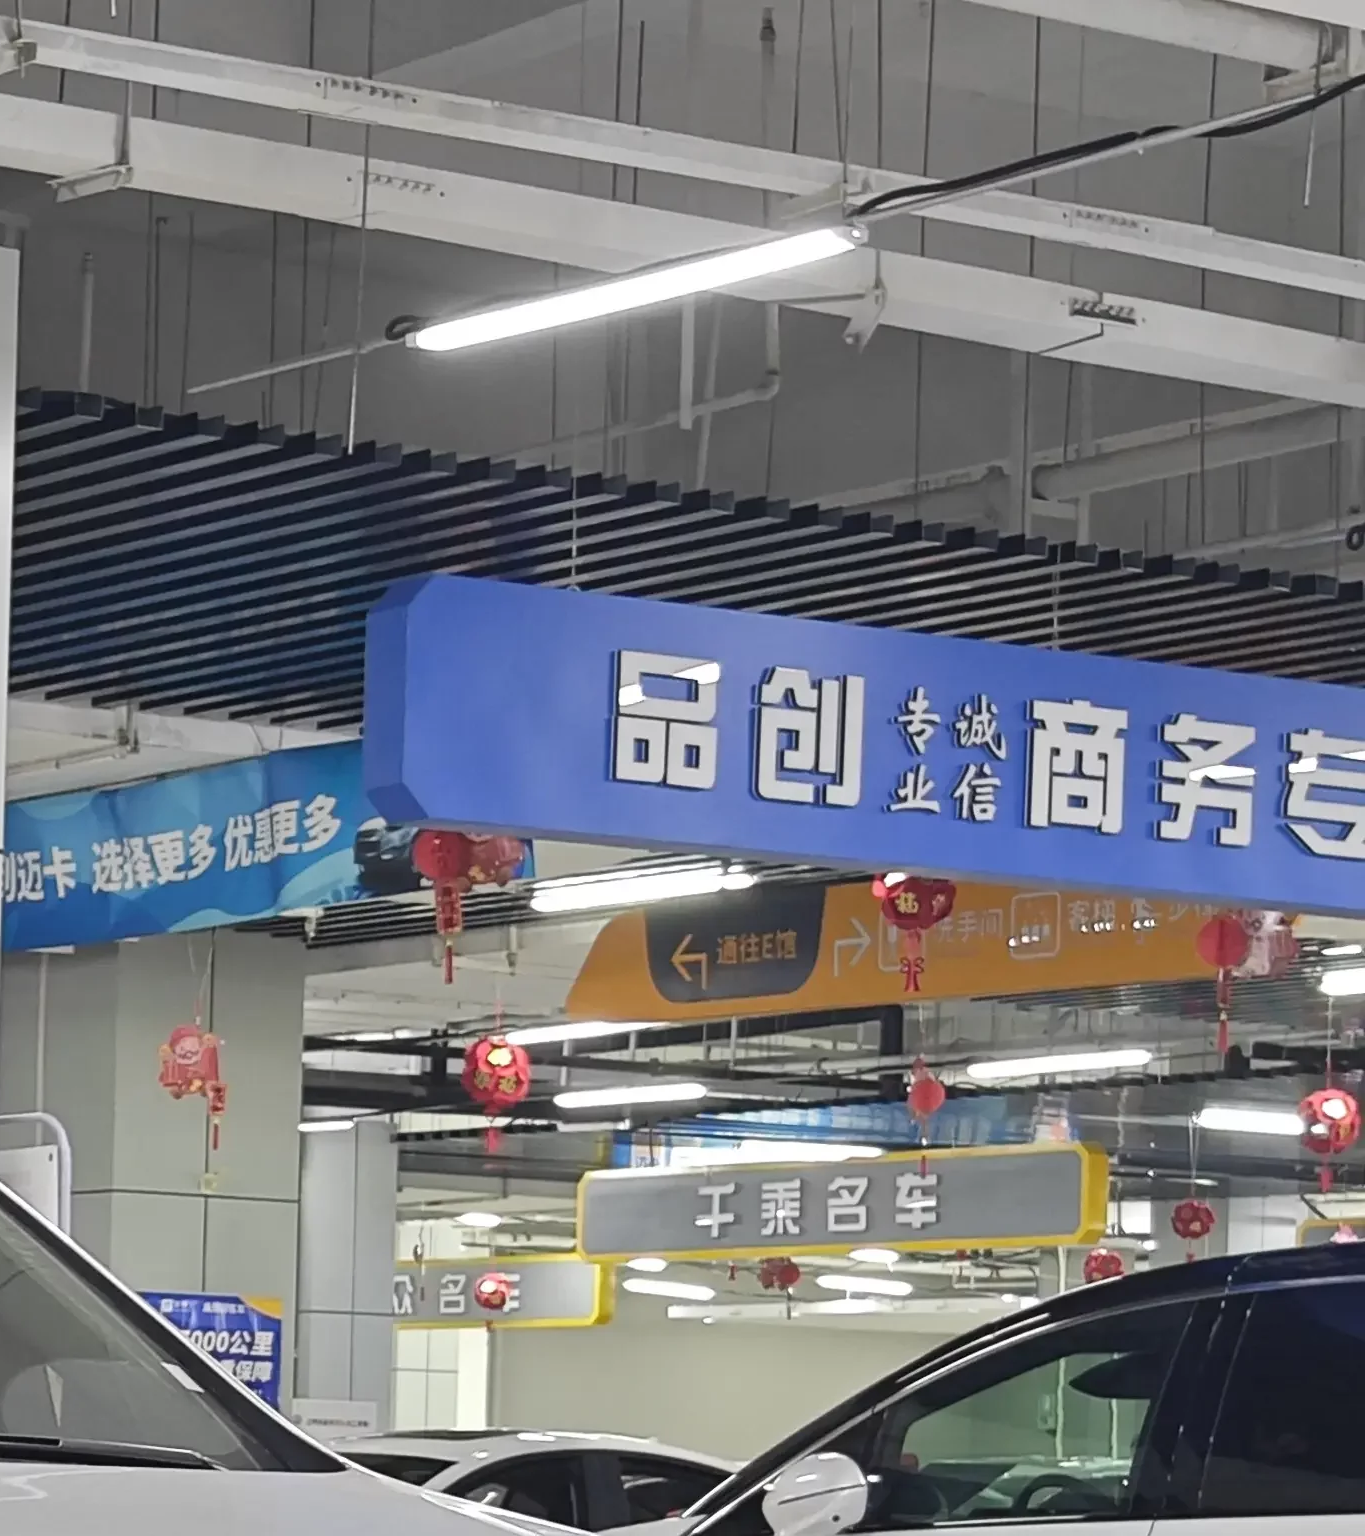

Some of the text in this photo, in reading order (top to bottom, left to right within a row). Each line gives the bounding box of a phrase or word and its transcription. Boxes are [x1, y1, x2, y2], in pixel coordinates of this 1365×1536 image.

[612, 649, 865, 807] 品创
[91, 823, 216, 894] 选择更多
[222, 794, 342, 873] 优惠更多
[715, 928, 798, 966] 通往E馆
